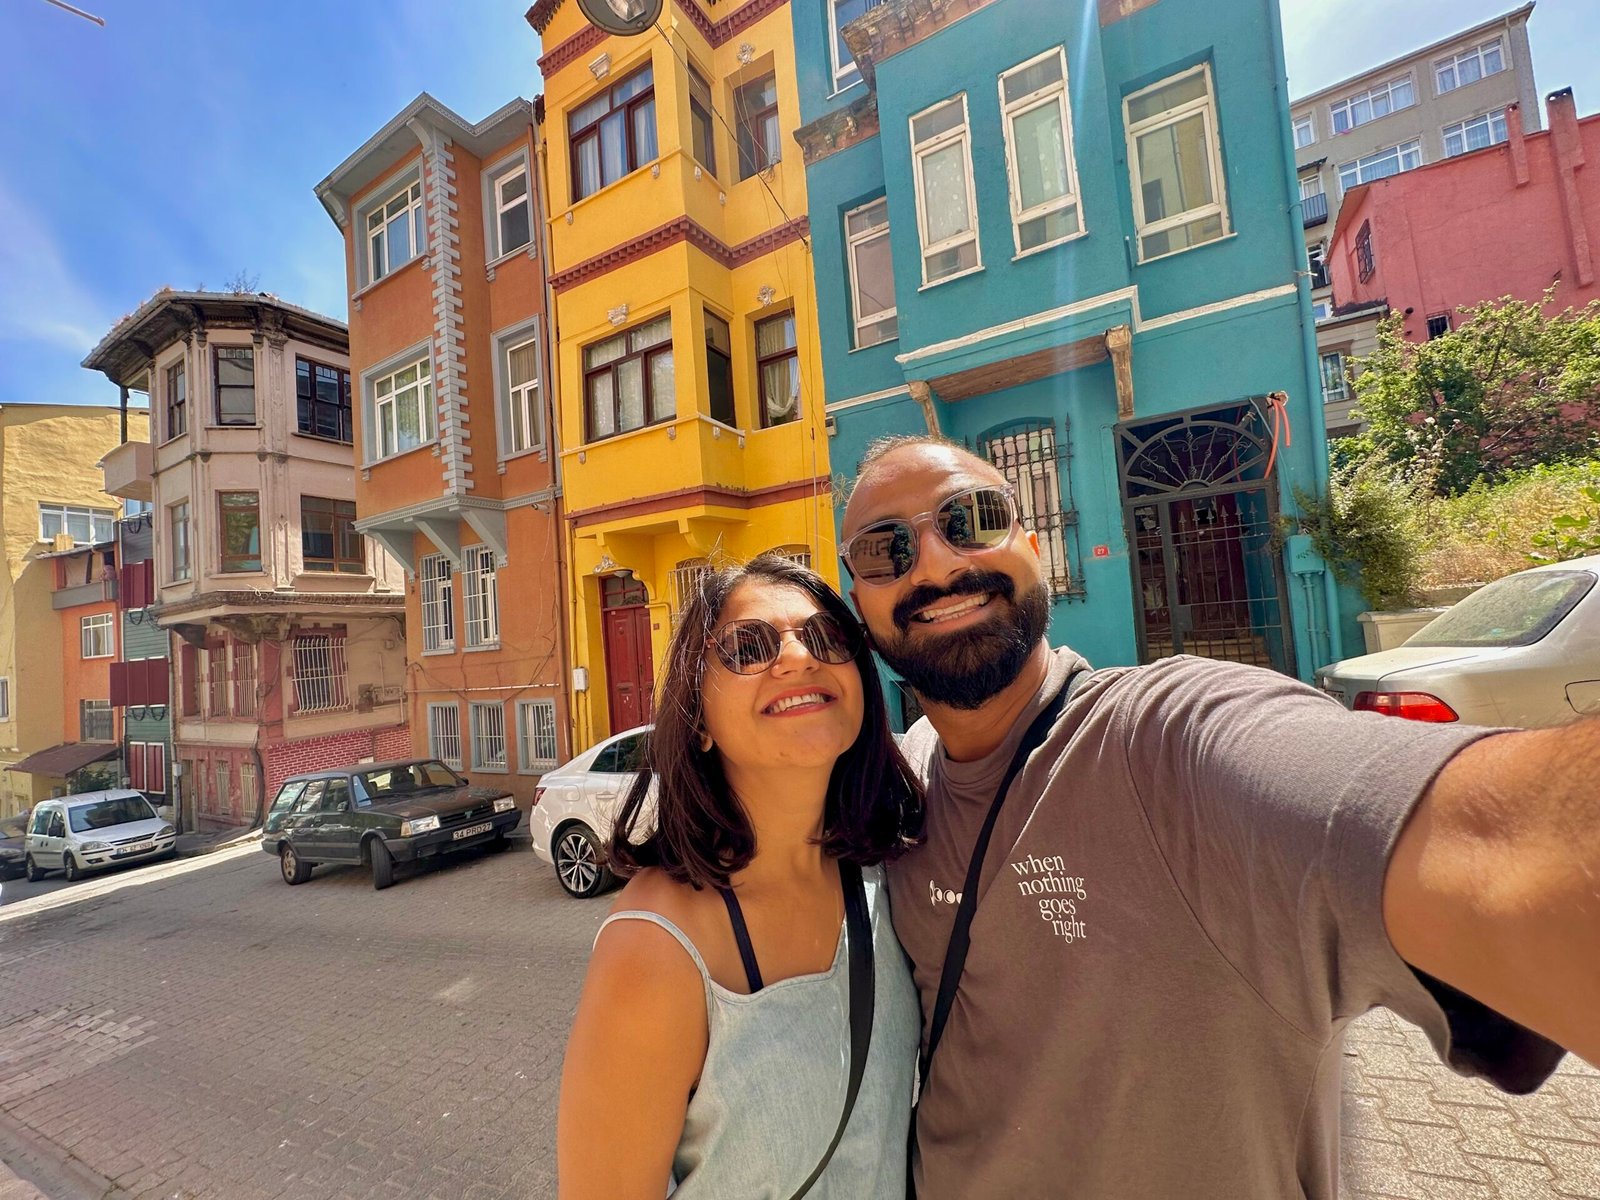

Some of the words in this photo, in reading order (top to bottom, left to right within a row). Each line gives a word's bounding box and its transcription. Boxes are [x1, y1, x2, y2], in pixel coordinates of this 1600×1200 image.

[454, 829, 464, 839] 34
[1011, 854, 1066, 876] when
[1018, 872, 1087, 900] nothing
[1039, 898, 1076, 921] goes
[1052, 914, 1087, 944] right
